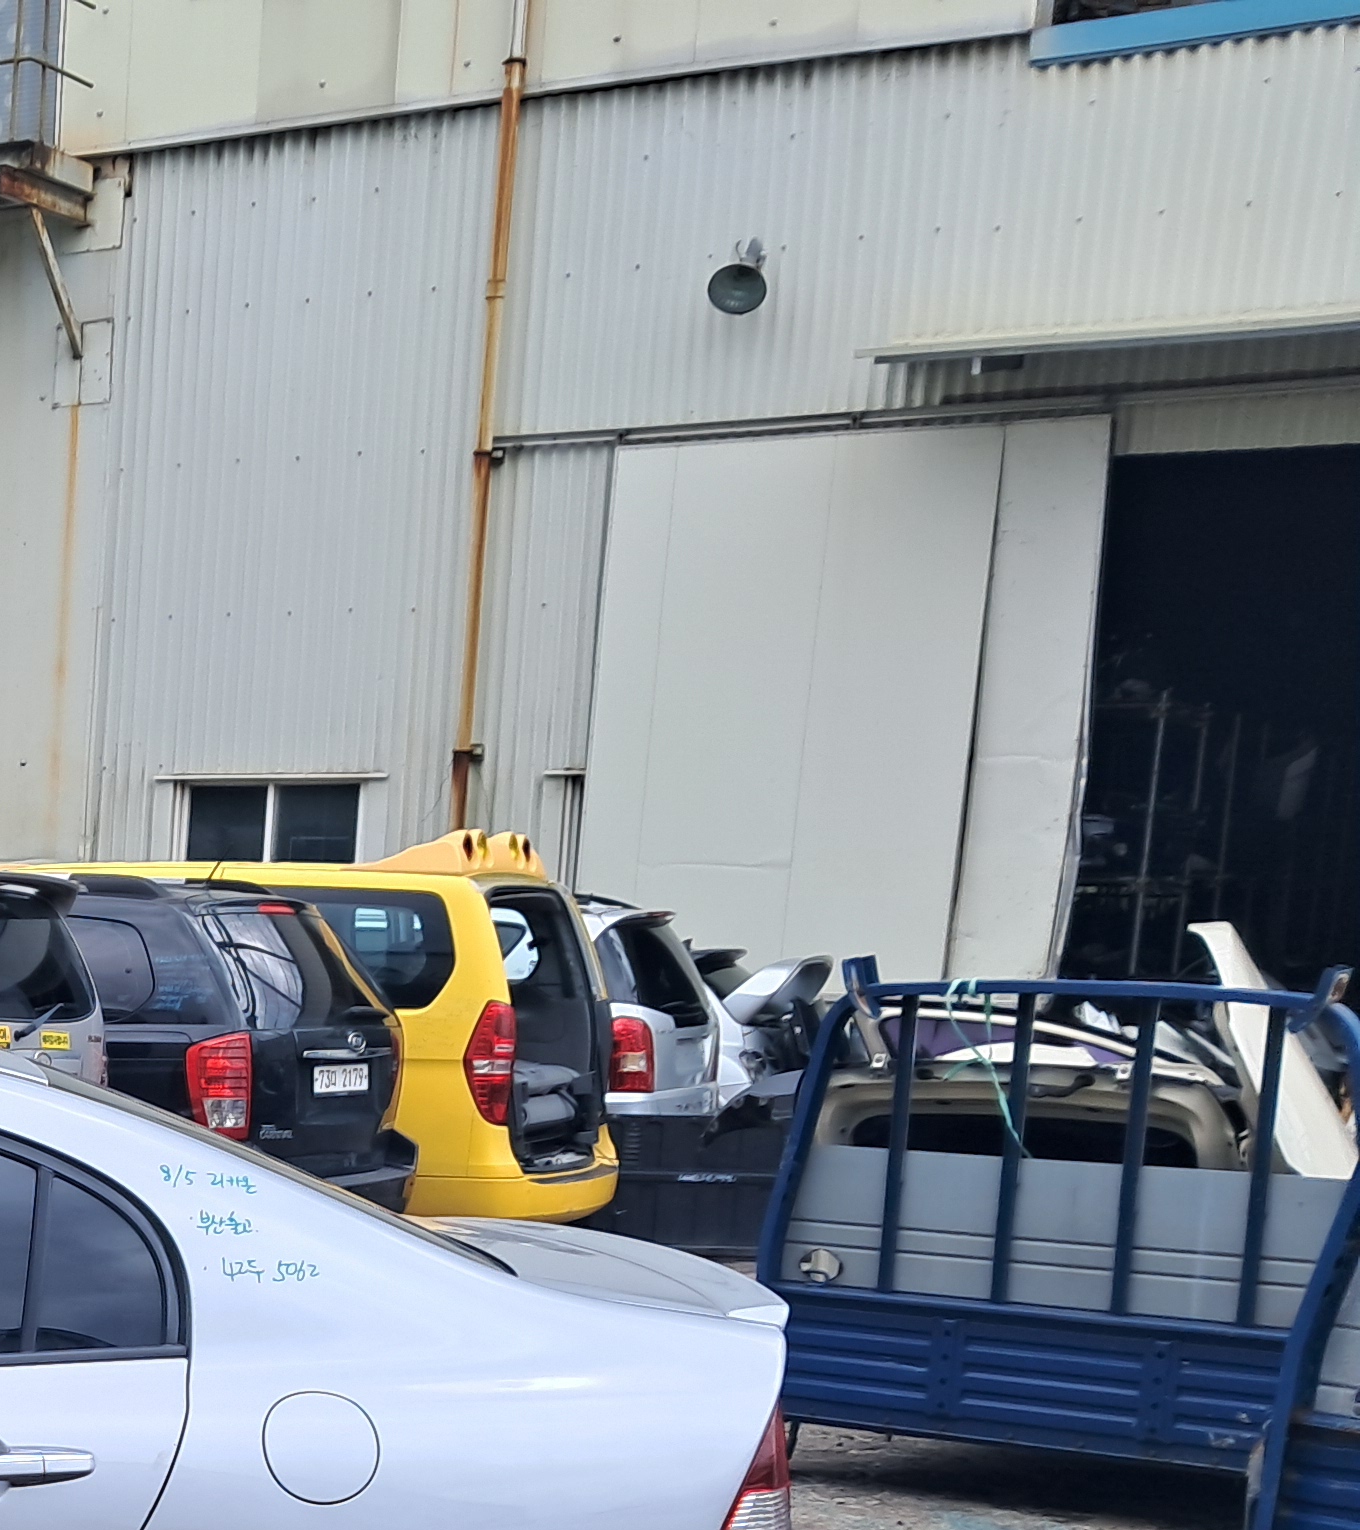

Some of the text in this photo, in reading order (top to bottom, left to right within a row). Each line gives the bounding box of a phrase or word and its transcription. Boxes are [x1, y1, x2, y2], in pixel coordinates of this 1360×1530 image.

[342, 1067, 364, 1088] 2179
[159, 1163, 197, 1188] 8/5
[272, 1259, 321, 1283] 5062
